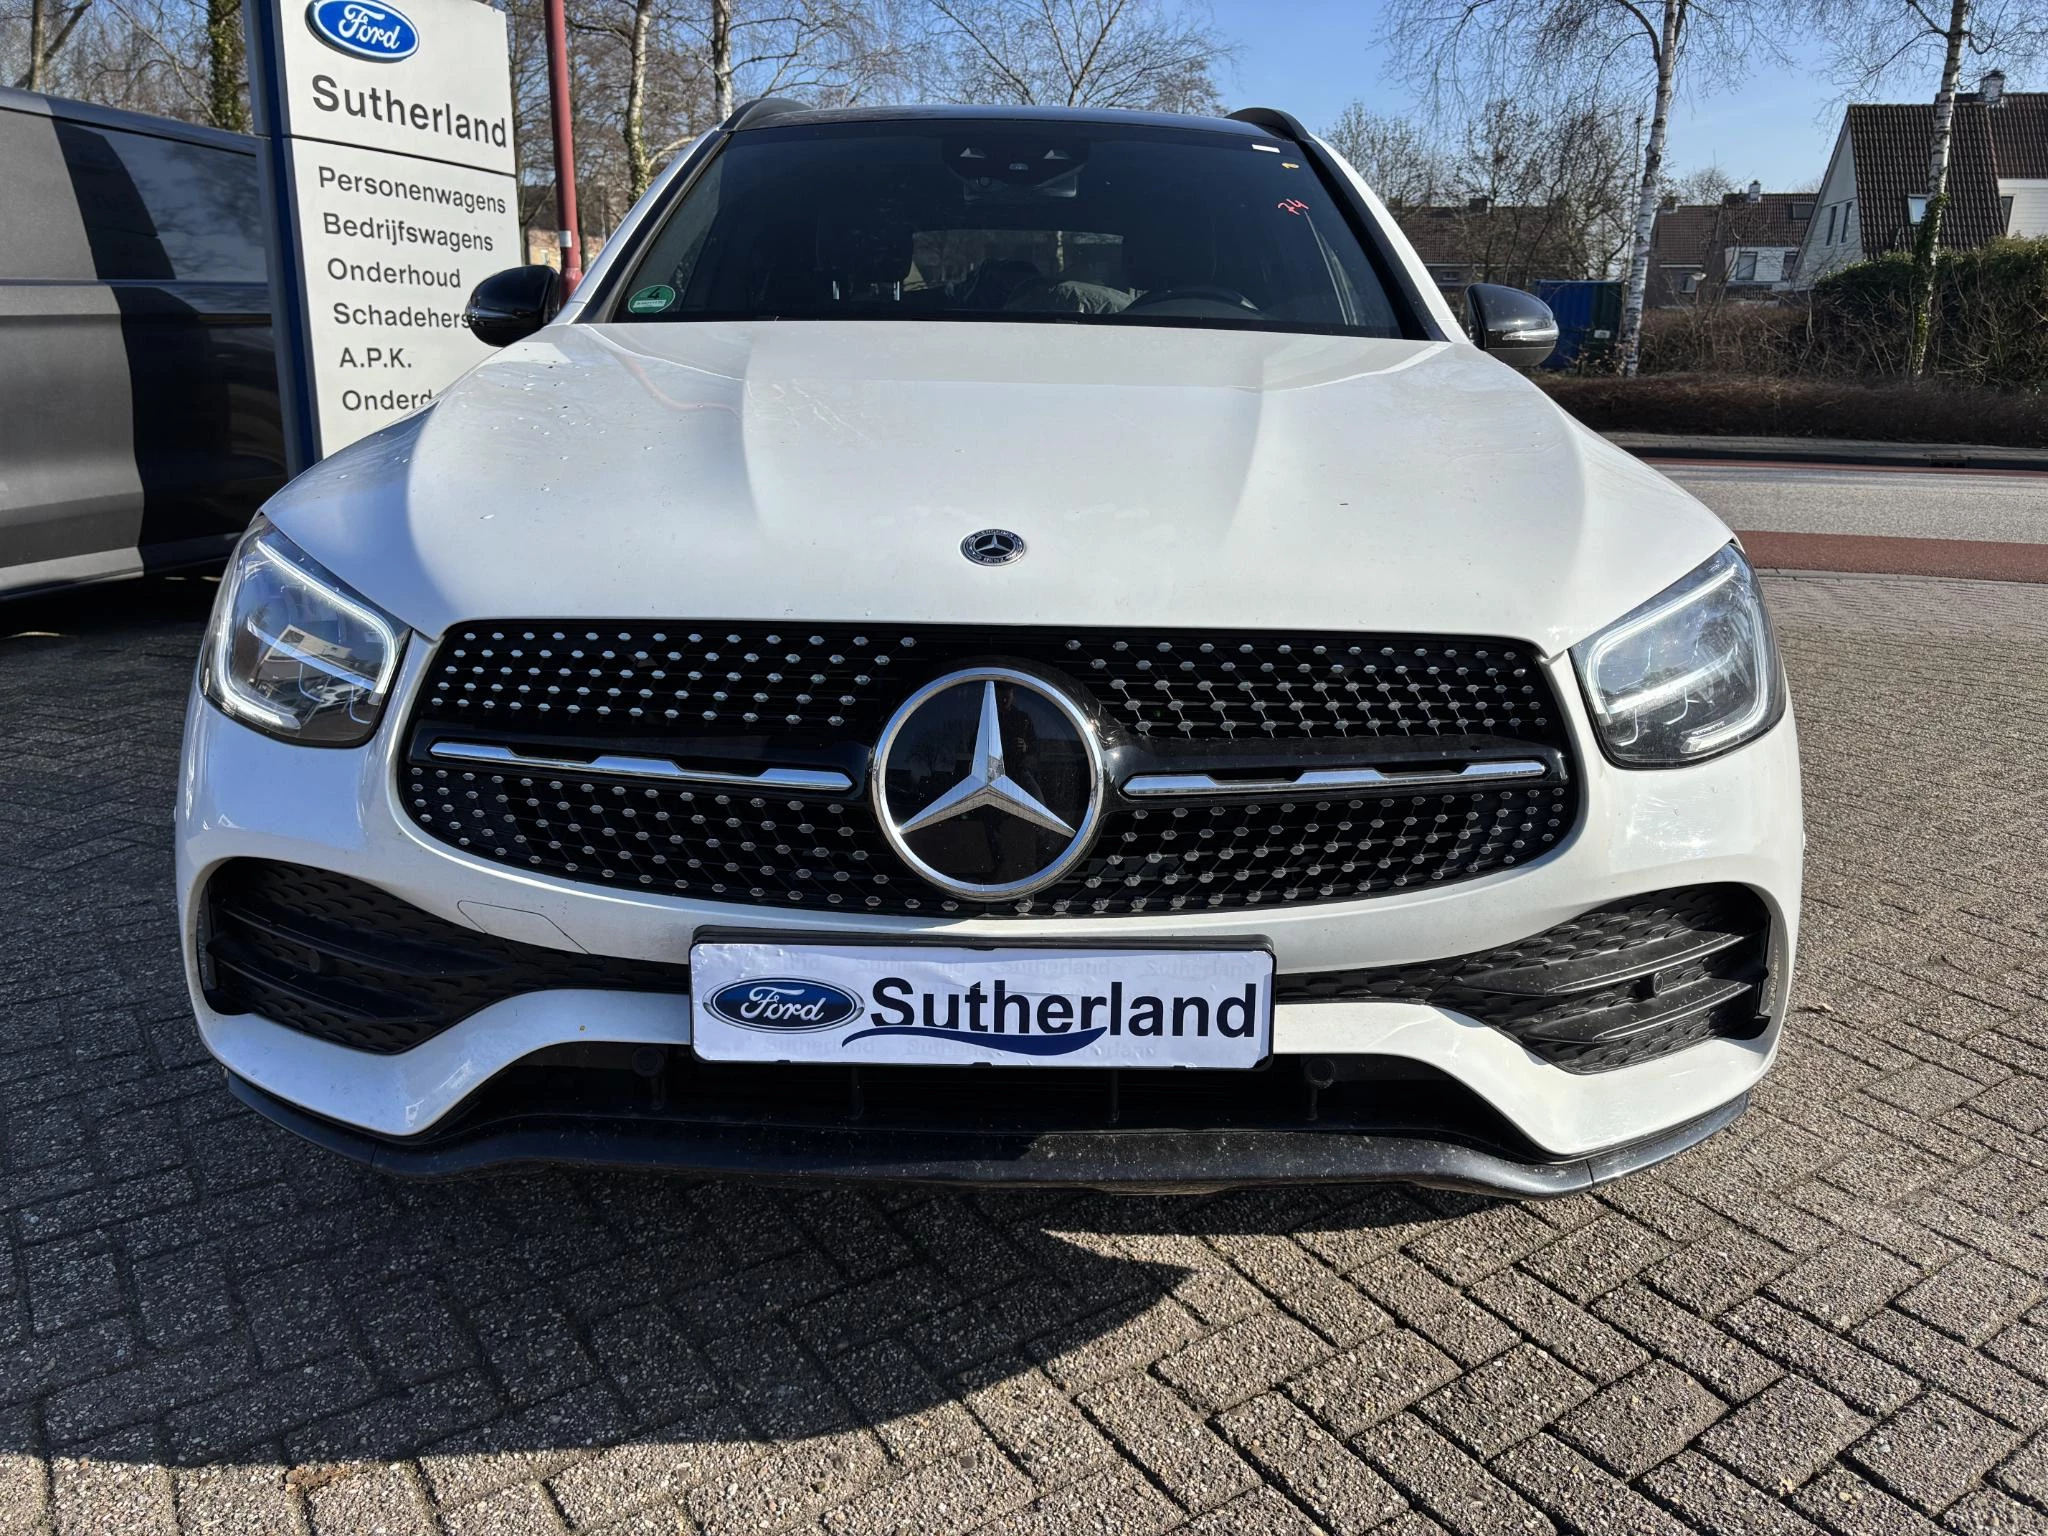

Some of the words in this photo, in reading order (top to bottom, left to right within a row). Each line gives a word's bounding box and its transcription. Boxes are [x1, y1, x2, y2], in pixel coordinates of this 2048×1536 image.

[338, 5, 401, 50] Ford
[312, 74, 507, 148] Sutherland
[318, 165, 507, 214] Personenwagens
[323, 211, 494, 252] Bedrijfswagens
[327, 257, 462, 288] Onderhoud
[333, 302, 470, 328] Schadehers
[339, 346, 413, 369] A.P.K.
[342, 389, 433, 411] Onderd
[740, 985, 827, 1022] Ford
[870, 977, 1257, 1038] Sutherland
